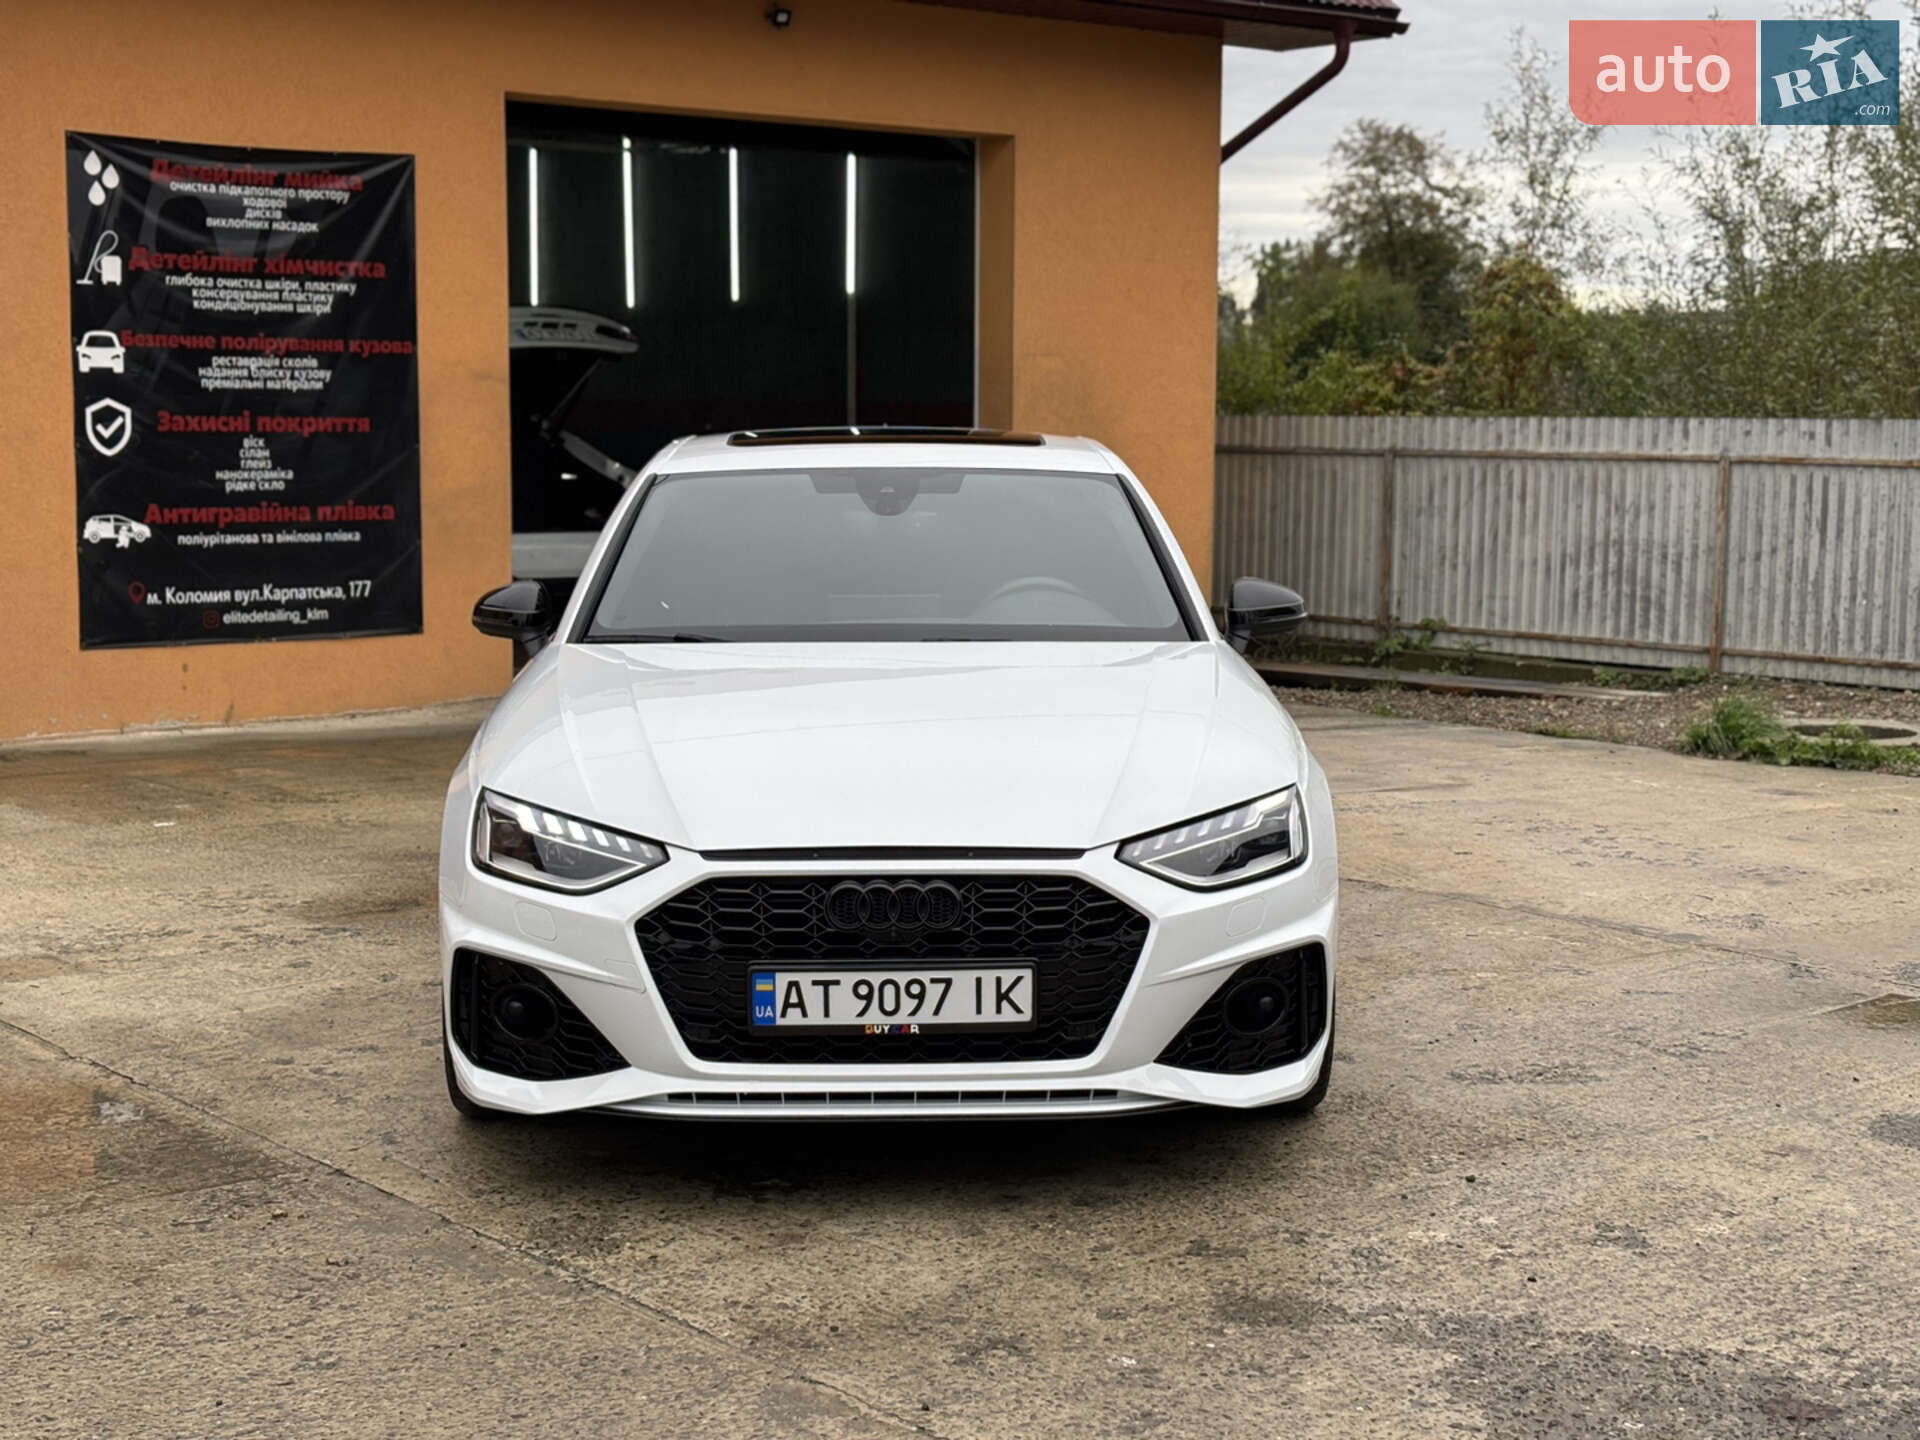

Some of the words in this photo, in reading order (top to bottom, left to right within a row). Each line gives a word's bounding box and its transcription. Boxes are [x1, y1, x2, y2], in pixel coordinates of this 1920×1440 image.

[150, 157, 278, 188] Детейлінг
[284, 169, 363, 191] мийка
[169, 181, 217, 193] очистка
[219, 182, 296, 199] підкапотного
[298, 189, 350, 205] простору
[242, 197, 287, 209] ходової
[244, 207, 282, 219] дисків
[206, 217, 270, 230] вихлопних
[272, 220, 319, 232] насадок
[128, 247, 257, 272] Детейлінг
[264, 253, 386, 278] хімчистка
[165, 272, 215, 287] глибока
[216, 278, 262, 290] очистка
[304, 281, 357, 296] пластику
[192, 288, 280, 303] консервування
[282, 289, 334, 304] пластику
[193, 299, 294, 315] кондиціонування
[296, 301, 332, 316] шкіри
[121, 330, 216, 349] Безпечне
[221, 333, 345, 356] полірування
[349, 339, 413, 358] кузова
[212, 355, 280, 370] реставрація
[282, 355, 319, 368] сколів
[198, 367, 248, 378] надання
[250, 366, 291, 380] блиску
[294, 369, 332, 383] кузову
[200, 377, 265, 392] преміальні
[266, 380, 324, 393] матеріали
[157, 410, 251, 433] Захисні
[257, 414, 371, 437] покриття
[243, 434, 265, 448] віск
[215, 466, 294, 481] нанокераміка
[225, 478, 257, 494] рідке
[258, 481, 286, 491] скло
[144, 502, 311, 528] Антигравійна
[317, 500, 396, 522] плівка
[177, 531, 259, 548] поліурітанова
[261, 533, 275, 544] та
[276, 529, 323, 543] вінілова
[325, 531, 361, 543] плівка
[146, 591, 163, 605] м.
[165, 586, 232, 605] Коломия
[233, 582, 347, 606] вул.Карпатська,
[348, 580, 373, 598] 177
[222, 607, 330, 624] elitedetailing_klm
[779, 979, 842, 1019] AT
[852, 977, 954, 1018] 9097
[974, 975, 1026, 1016] IK
[755, 1005, 774, 1018] UA
